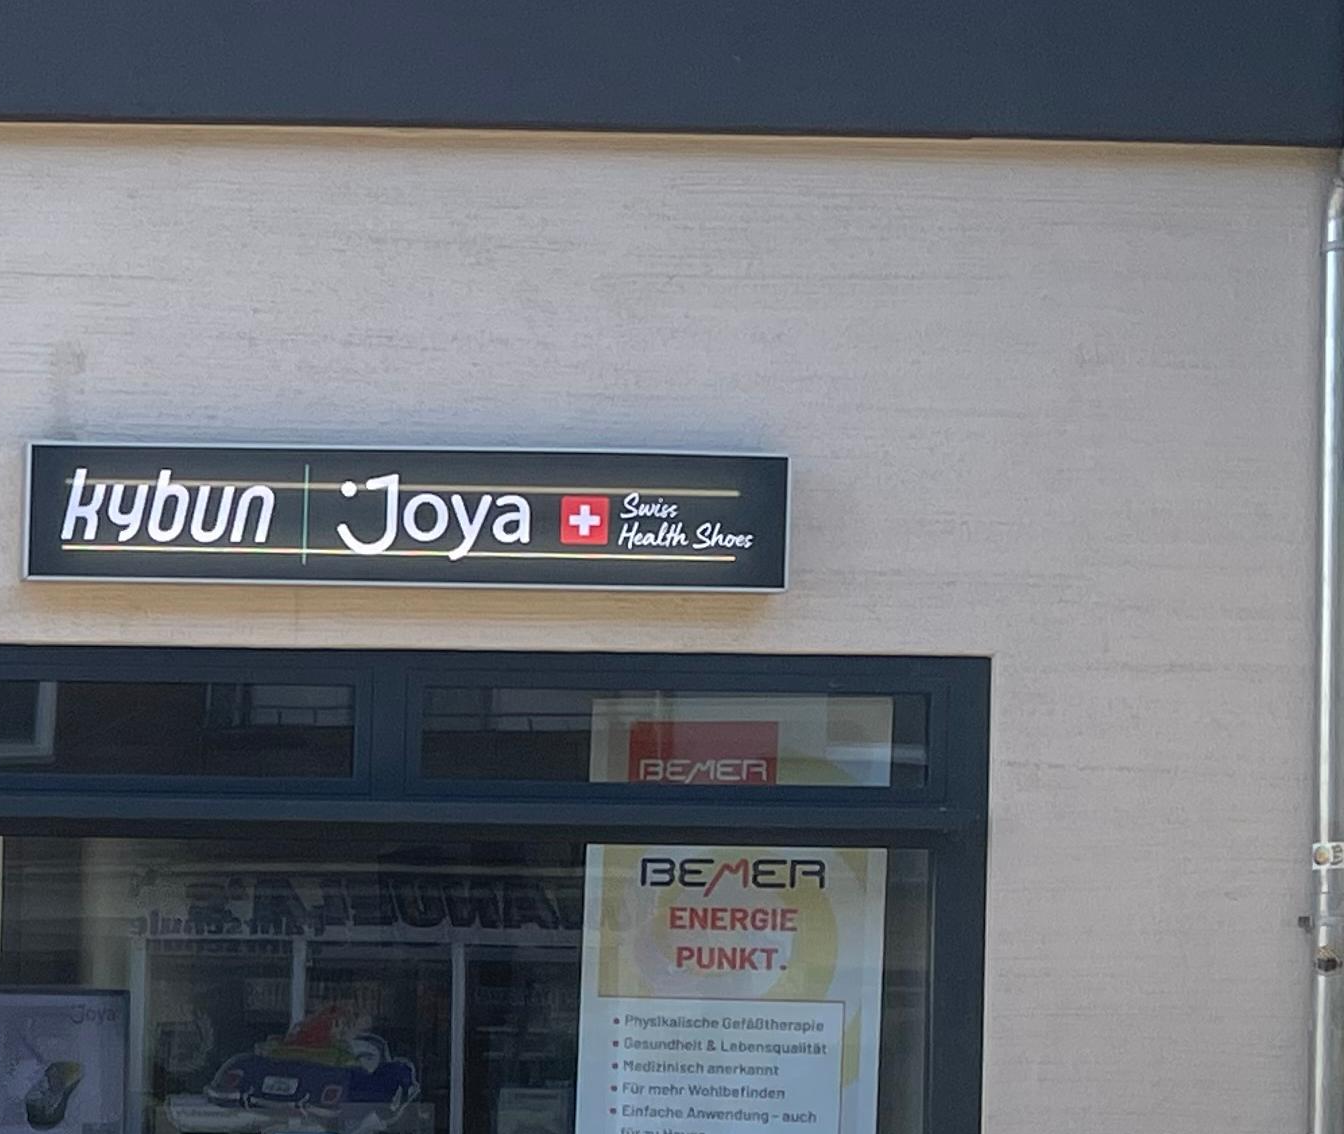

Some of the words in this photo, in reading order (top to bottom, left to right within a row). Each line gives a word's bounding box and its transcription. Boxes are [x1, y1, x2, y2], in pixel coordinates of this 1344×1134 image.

[61, 468, 275, 543] kybun
[336, 473, 530, 560] Joya
[620, 492, 678, 518] Swiss
[618, 521, 689, 549] Health
[692, 522, 753, 549] Shoes
[639, 758, 768, 784] BEMER
[640, 858, 826, 897] BEMER
[668, 906, 799, 932] ENERGIE
[675, 946, 788, 971] PUNKT.
[624, 1015, 719, 1030] Physikalische
[722, 1017, 824, 1033] Gefäßtherapie
[624, 1037, 702, 1051] Gesundheit
[706, 1039, 716, 1051] &
[720, 1040, 827, 1055] Lebensqualität
[623, 1059, 703, 1073] Medizinisch
[706, 1062, 779, 1076] anerkannt
[622, 1082, 646, 1095] Für
[648, 1083, 684, 1096] mehr
[687, 1084, 785, 1099] Wohlbefinden
[621, 1104, 683, 1119] Einfache
[686, 1106, 769, 1124] Anwendung
[782, 1110, 817, 1123] auch
